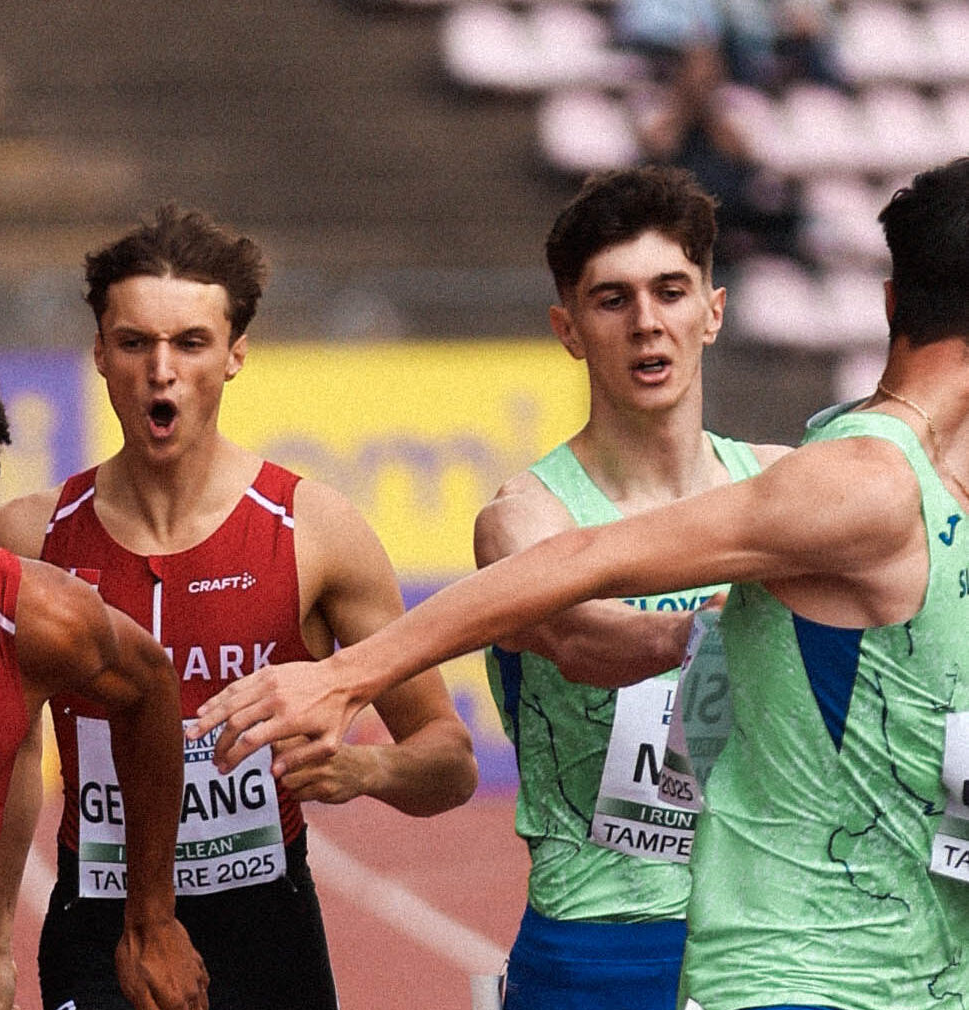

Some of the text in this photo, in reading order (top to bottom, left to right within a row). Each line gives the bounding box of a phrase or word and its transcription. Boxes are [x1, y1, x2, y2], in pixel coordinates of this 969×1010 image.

[188, 576, 242, 593] CRAFT
[641, 807, 693, 827] I RUN
[217, 853, 275, 884] 2025
